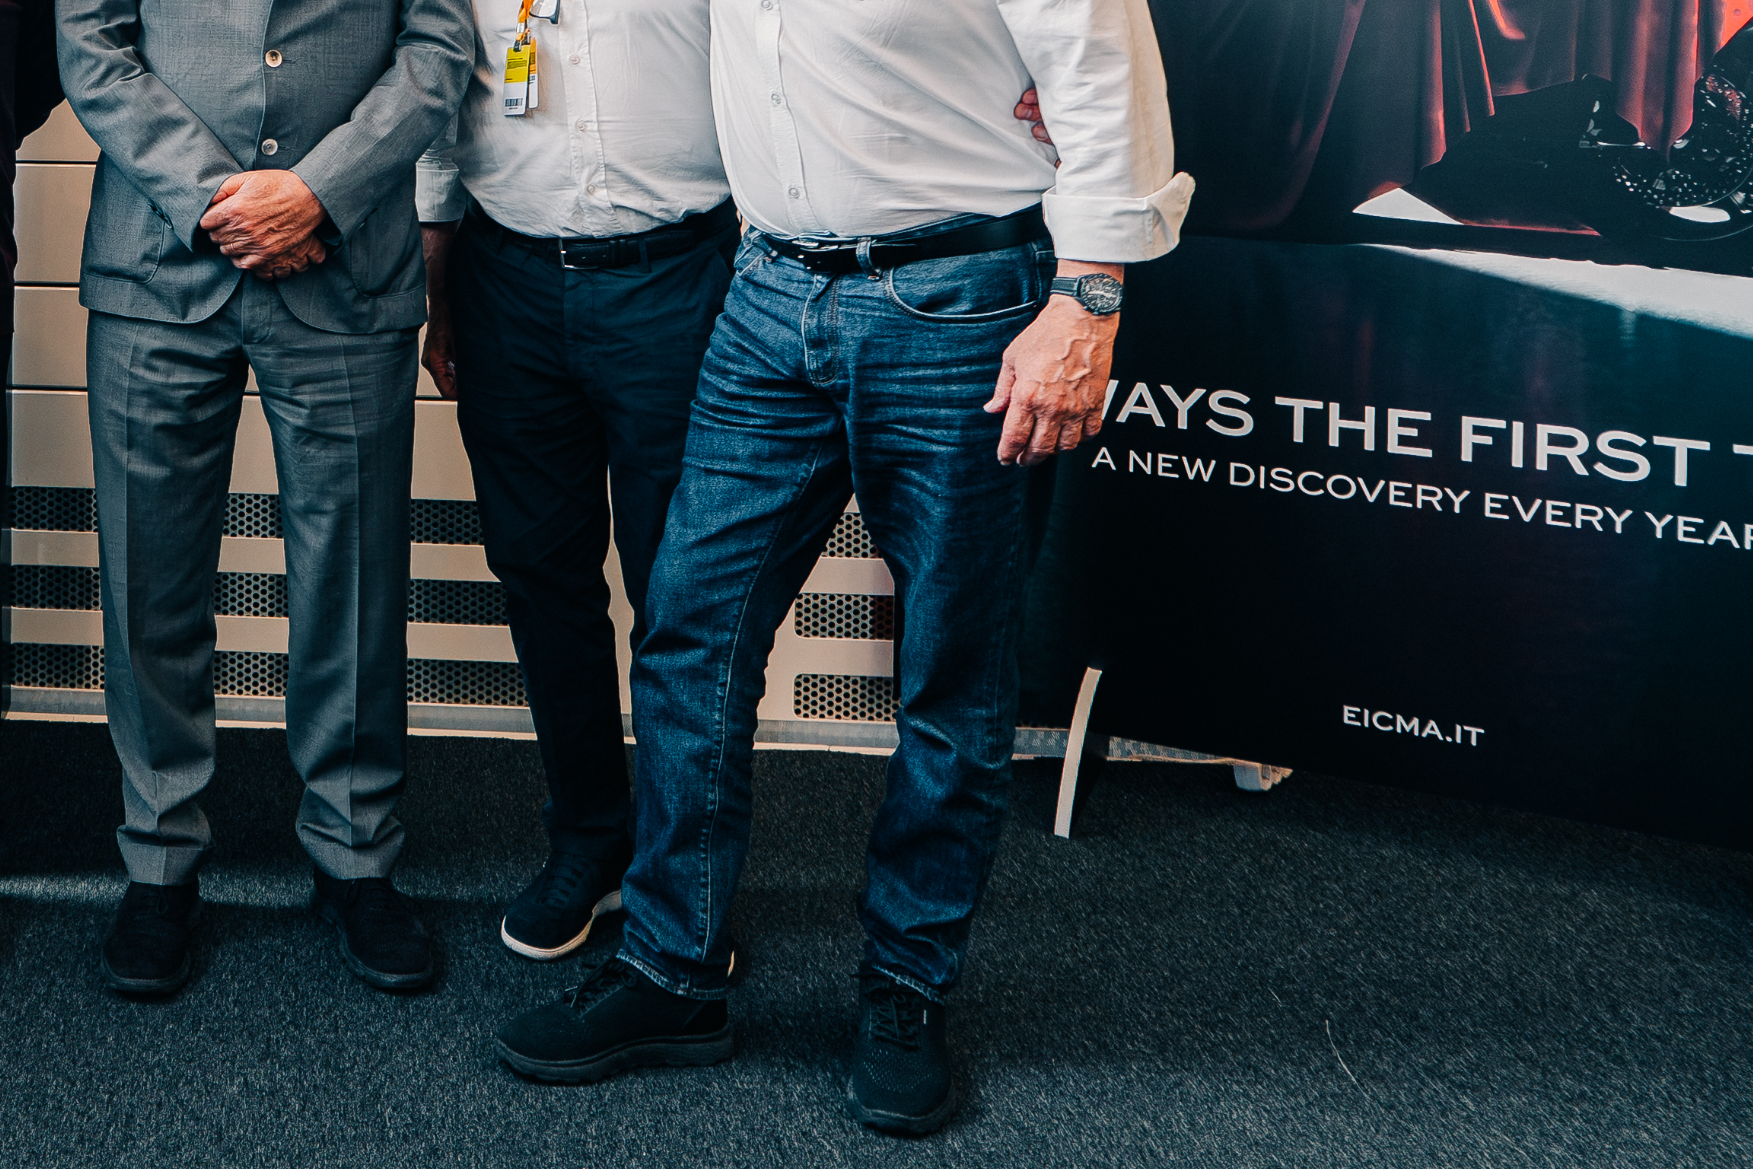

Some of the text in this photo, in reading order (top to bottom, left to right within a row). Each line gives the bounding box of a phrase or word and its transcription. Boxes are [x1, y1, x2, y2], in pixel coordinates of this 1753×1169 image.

[1102, 379, 1711, 487] AYS THE FIRST
[1091, 446, 1117, 470] A
[1128, 449, 1216, 482] NEW
[1230, 462, 1471, 514] DISCOVERY
[1484, 492, 1633, 534] EVERY
[1343, 704, 1485, 746] EICMA.IT
